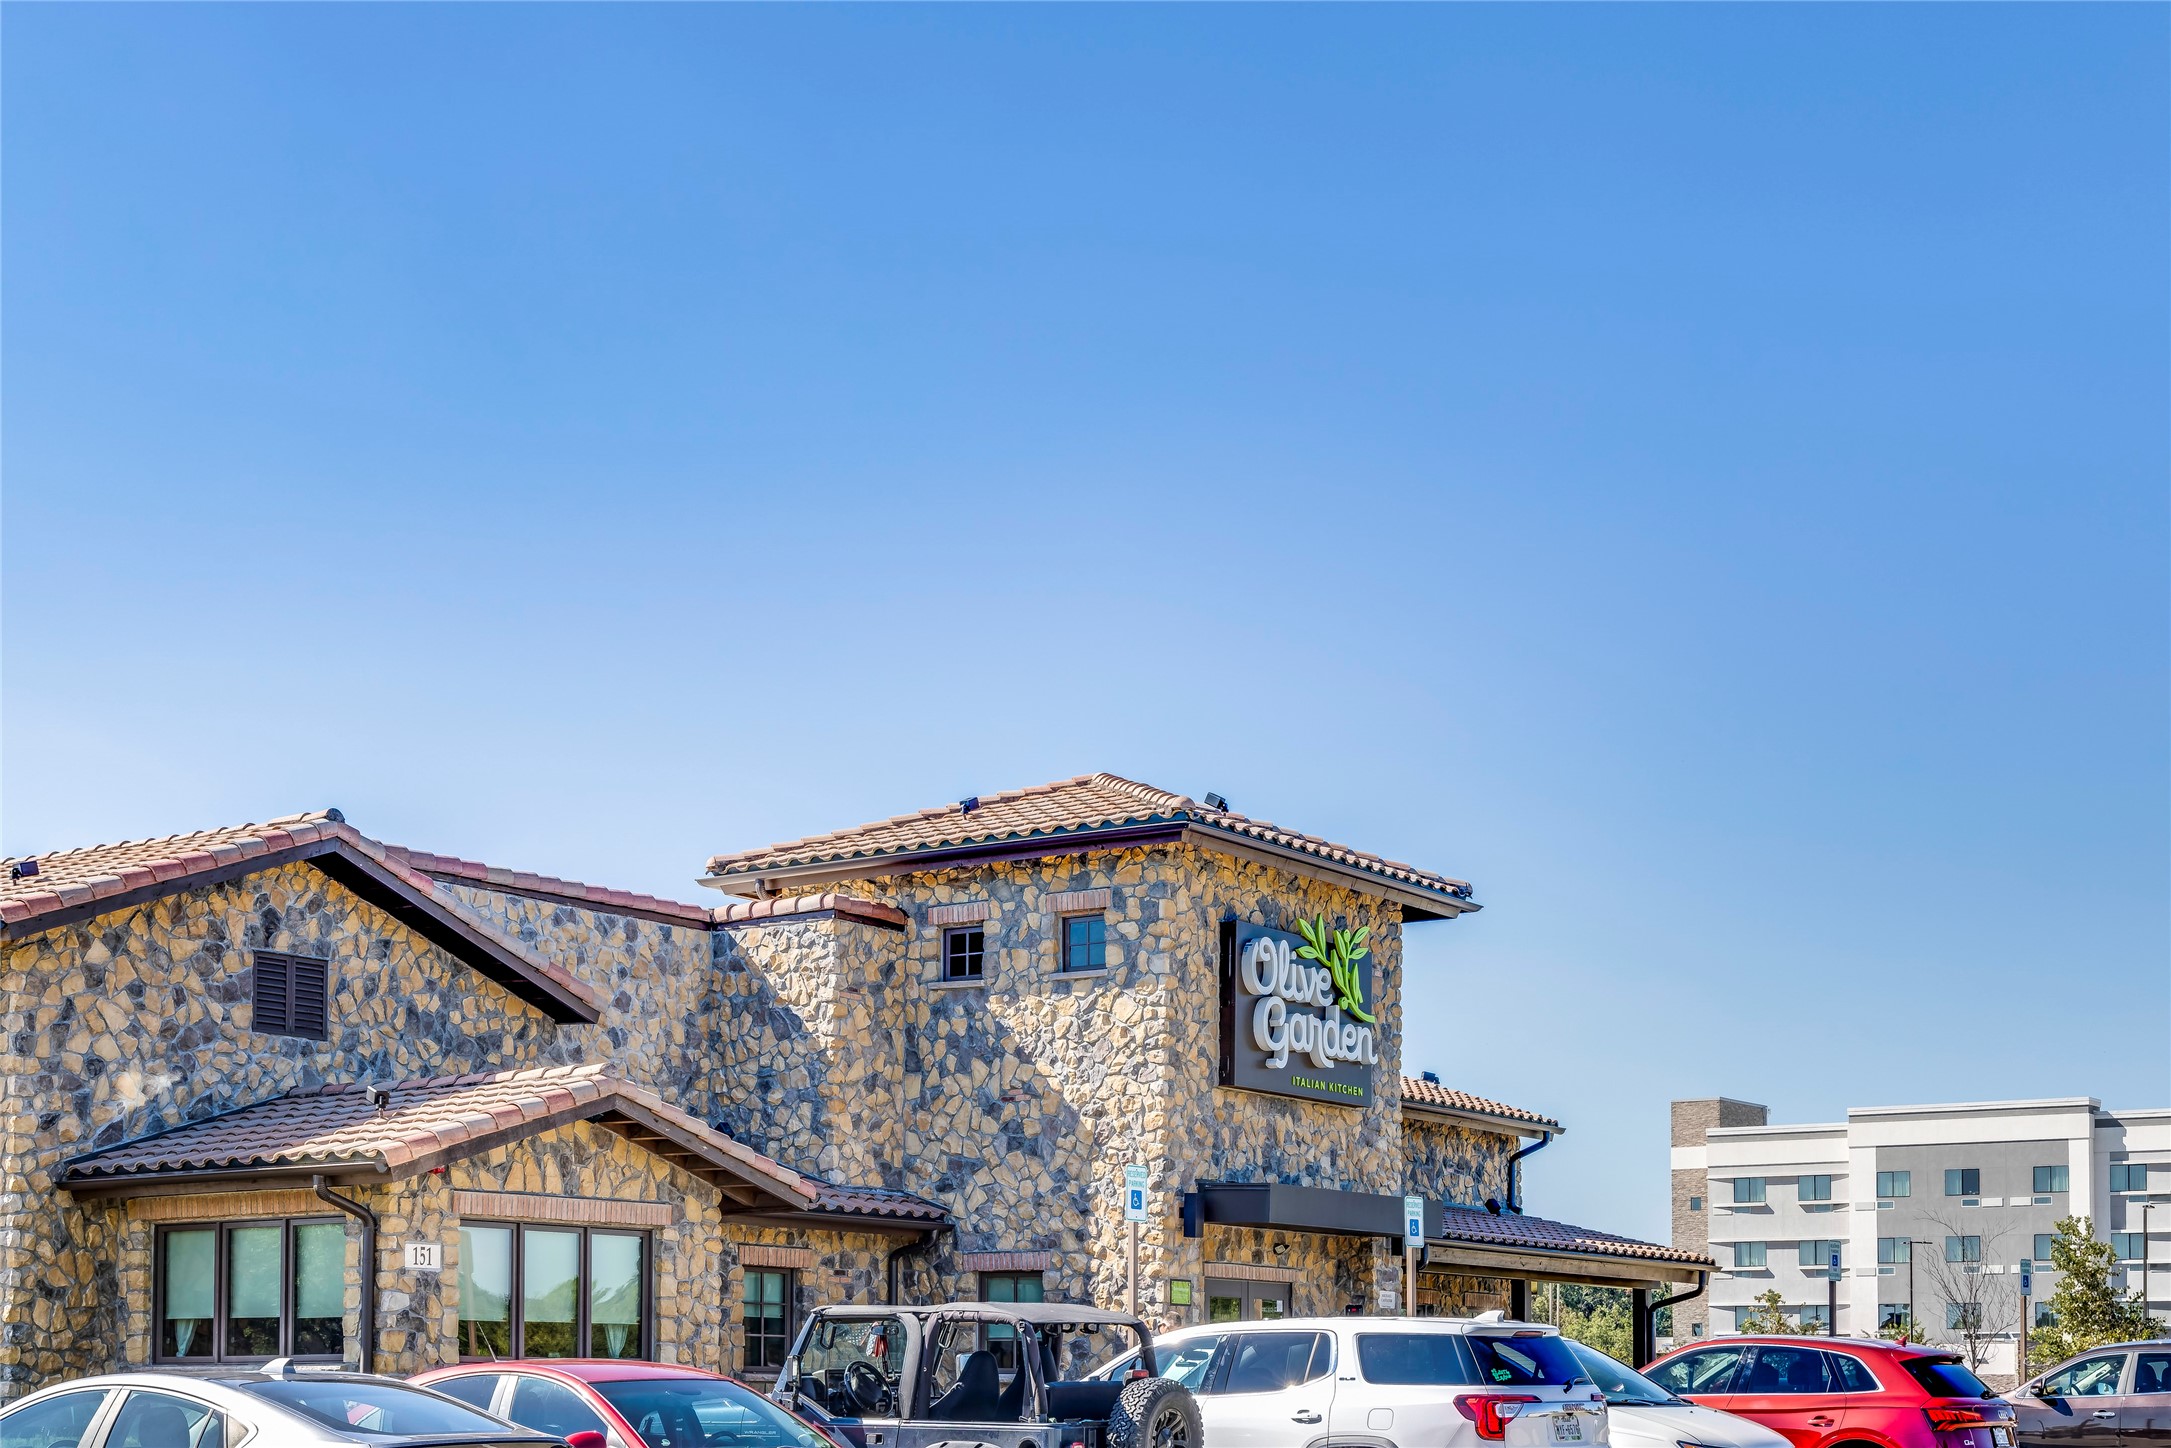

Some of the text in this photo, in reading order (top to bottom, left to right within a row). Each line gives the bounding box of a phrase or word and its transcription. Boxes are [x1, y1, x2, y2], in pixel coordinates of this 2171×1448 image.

[1242, 937, 1333, 1006] Olive
[1253, 996, 1378, 1068] Garden
[1292, 1076, 1364, 1097] ITALIAN KITCHEN
[413, 1246, 432, 1266] 151
